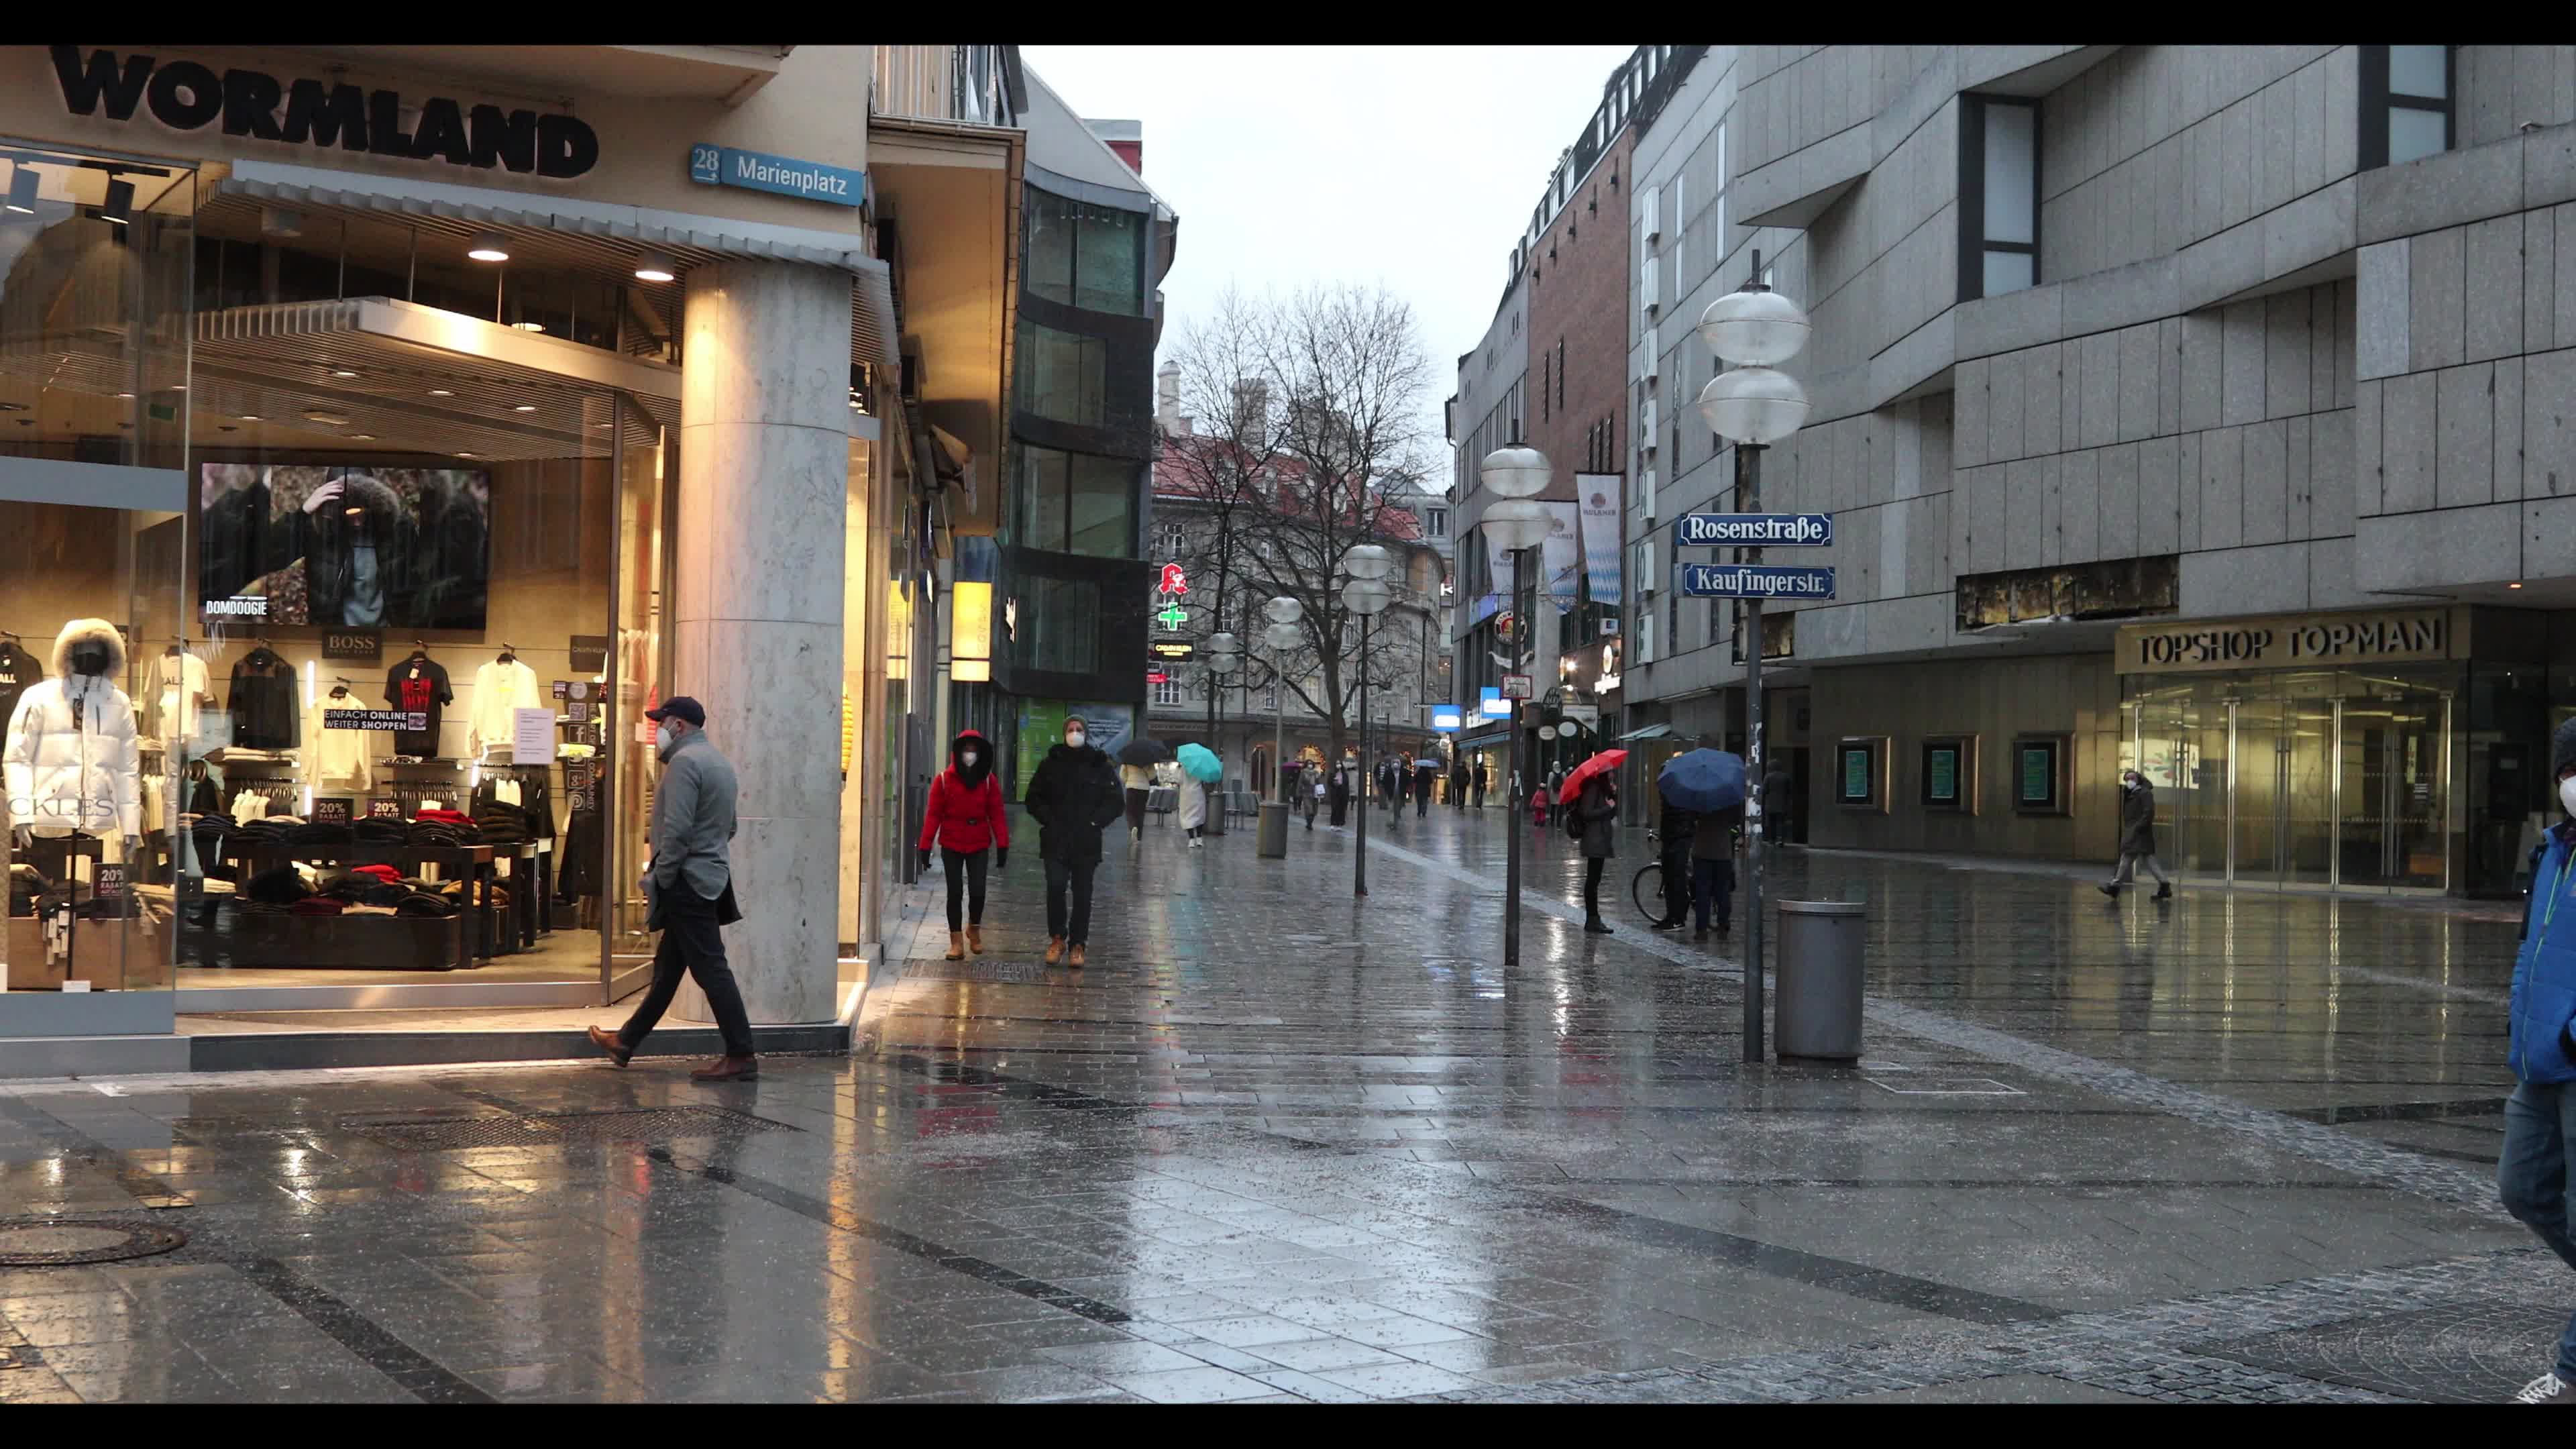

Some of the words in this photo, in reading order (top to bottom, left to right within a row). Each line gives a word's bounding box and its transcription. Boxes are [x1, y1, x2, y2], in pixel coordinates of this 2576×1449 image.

[50, 45, 599, 178] WORMLAND
[694, 148, 719, 170] 28
[738, 156, 847, 195] Marienplatz
[1690, 517, 1823, 542] Rosenstraße
[1697, 568, 1825, 595] Kaufingerstr.
[206, 600, 268, 615] BOMBOOGIE
[329, 635, 376, 650] BOSS
[2138, 628, 2273, 664] TOPSHOP
[2287, 619, 2440, 657] TOPMAN
[325, 710, 367, 719] EINFACH
[370, 712, 407, 720] ONLINE
[326, 720, 358, 729] WEITER
[361, 721, 407, 730] SHOPPEN
[319, 803, 345, 814] 20%
[374, 802, 399, 812] 20%
